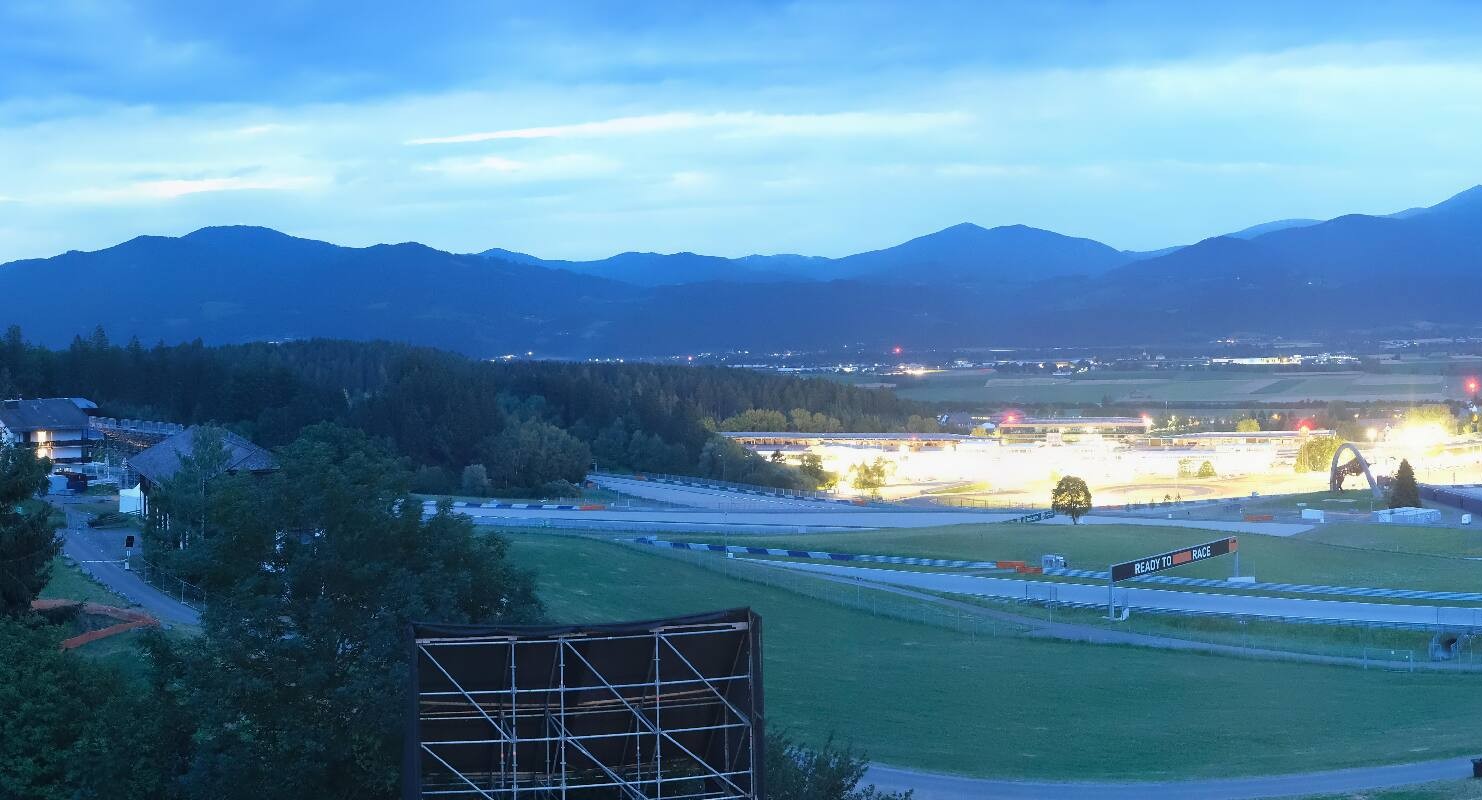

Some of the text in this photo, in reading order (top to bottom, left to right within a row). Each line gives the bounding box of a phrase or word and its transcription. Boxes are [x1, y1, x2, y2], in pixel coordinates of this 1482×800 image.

[1134, 546, 1211, 575] READY TO RACE
